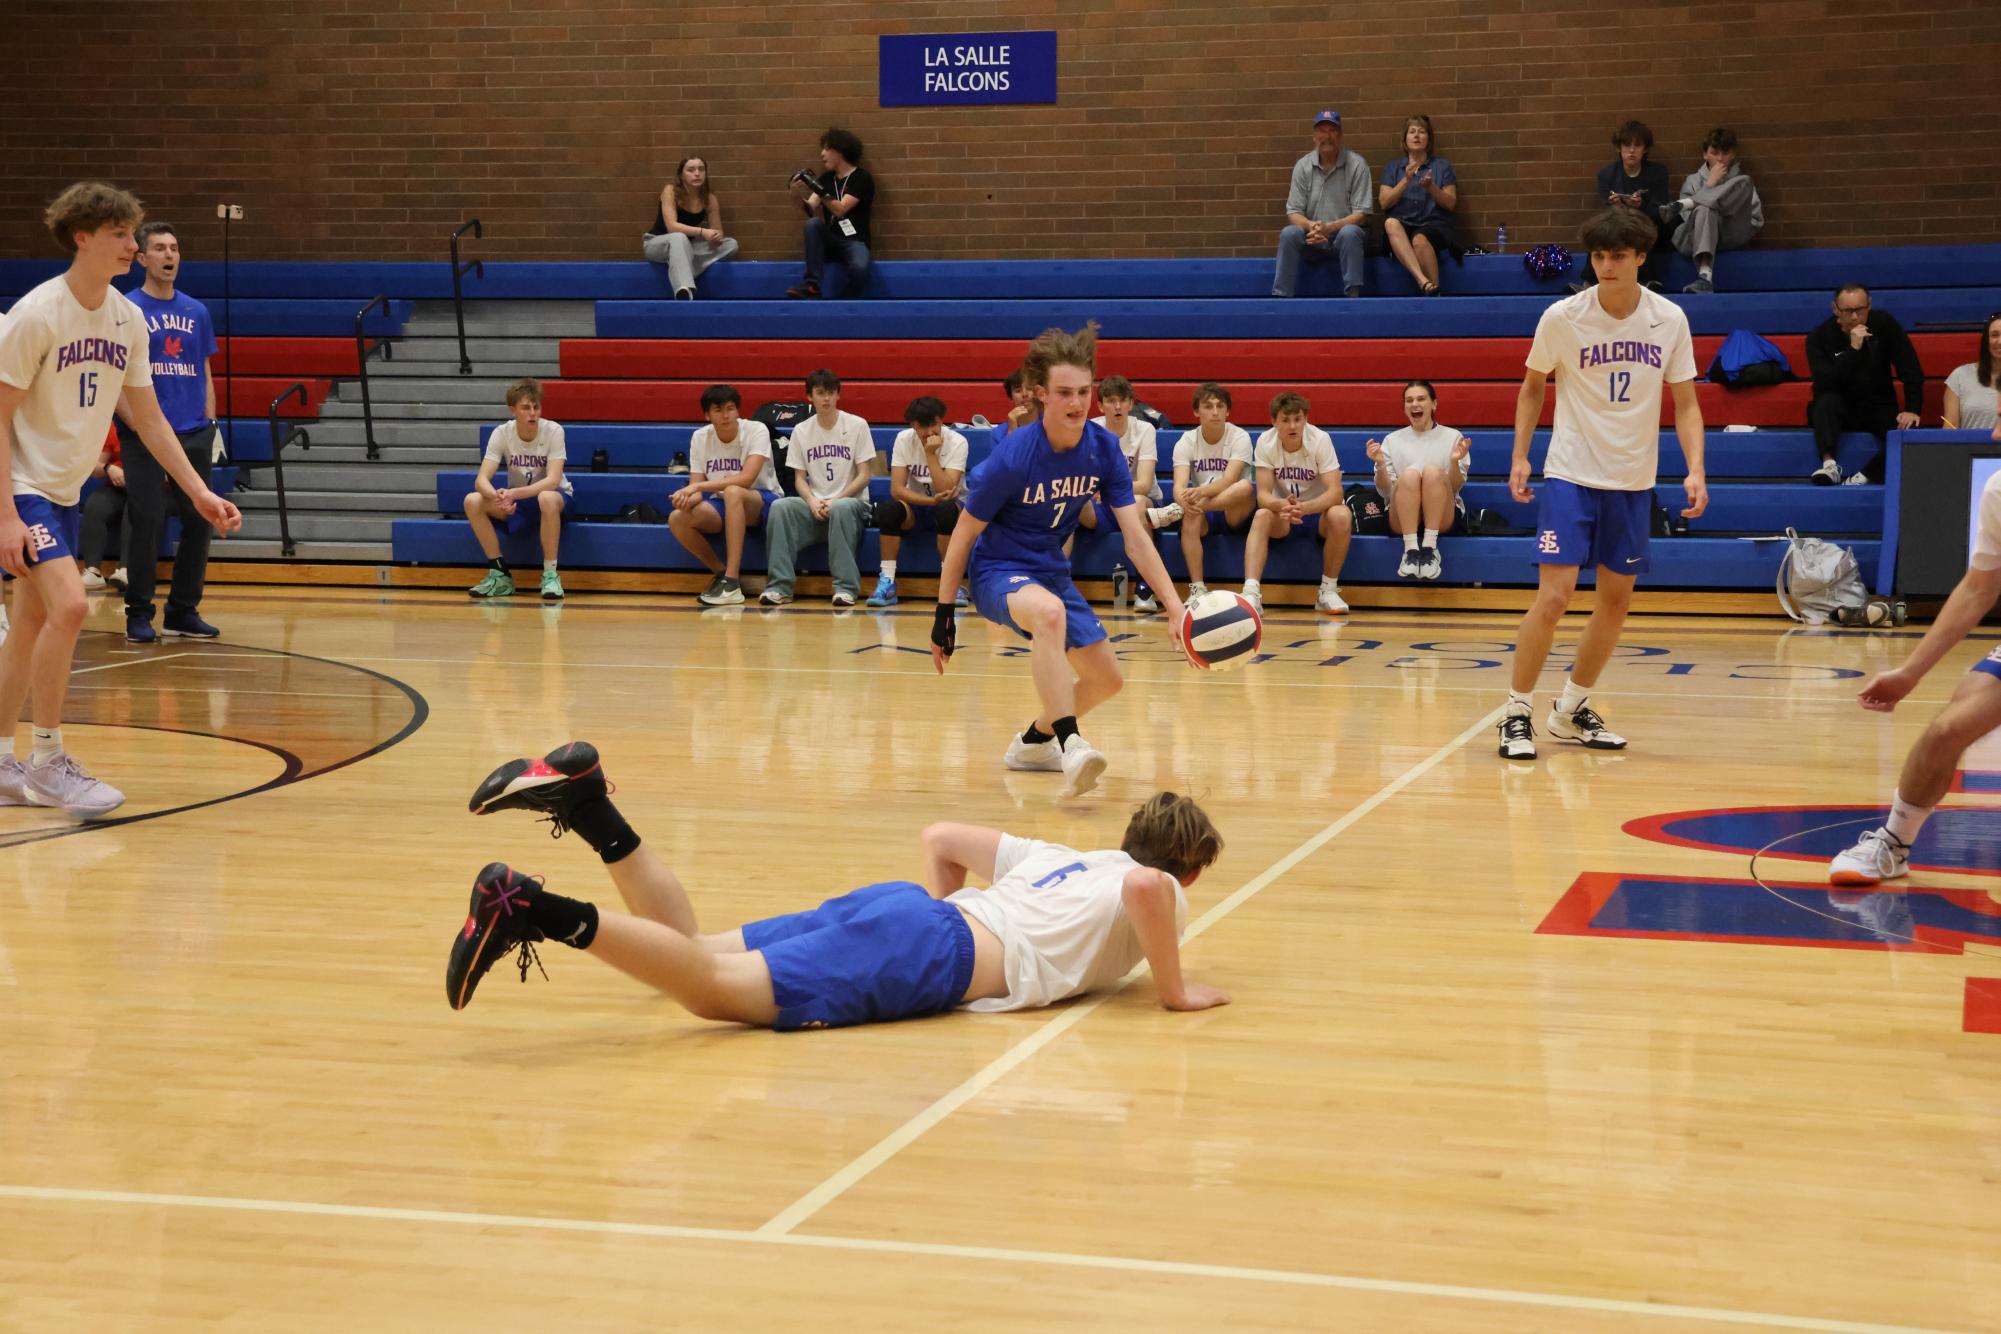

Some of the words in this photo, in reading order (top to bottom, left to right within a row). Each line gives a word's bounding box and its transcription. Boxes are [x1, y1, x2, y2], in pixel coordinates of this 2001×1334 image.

[924, 47, 949, 67] LA
[954, 45, 1010, 67] SALLE
[924, 71, 1010, 92] FALCONS
[145, 315, 161, 333] LA
[162, 314, 195, 334] SALLE
[57, 337, 128, 372] FALCONS
[1580, 341, 1662, 370] FALCONS
[150, 362, 197, 377] VOLLEYBALL
[79, 372, 98, 408] 15
[1610, 371, 1631, 402] 12
[807, 444, 852, 464] FALCONS
[826, 462, 834, 482] 5
[906, 464, 930, 478] FALC
[1191, 457, 1229, 473] FALCOS
[1273, 466, 1317, 481] FACONS
[1022, 482, 1046, 504] LA
[1050, 475, 1101, 500] SALLE
[1049, 501, 1067, 529] 7
